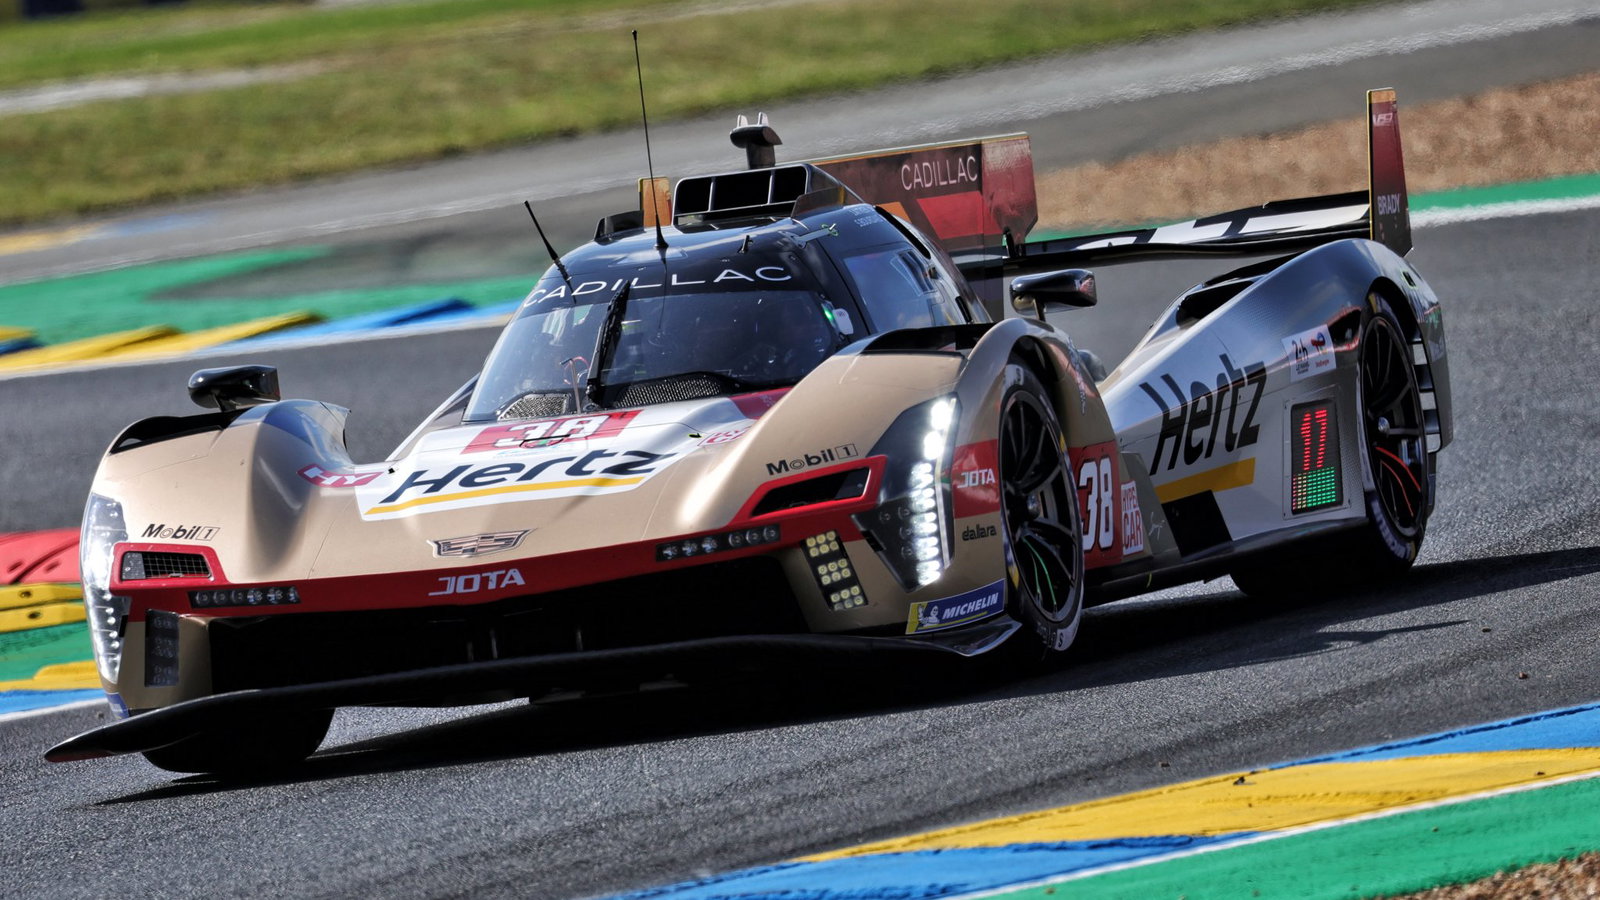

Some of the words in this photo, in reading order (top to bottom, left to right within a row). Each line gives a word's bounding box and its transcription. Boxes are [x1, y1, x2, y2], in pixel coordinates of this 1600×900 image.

[901, 155, 978, 191] CADILLAC
[1377, 193, 1401, 215] BRADY
[523, 266, 792, 308] CADILLAC
[1139, 353, 1267, 476] Hertz
[379, 448, 680, 504] Hertz
[765, 448, 835, 476] Mobil
[956, 468, 996, 489] JOTA
[1078, 457, 1115, 551] 38
[141, 523, 202, 540] Mobil
[961, 523, 997, 541] dallara
[1123, 509, 1143, 550] CAR
[427, 568, 526, 596] JOTA
[941, 592, 999, 620] MICHELIN
